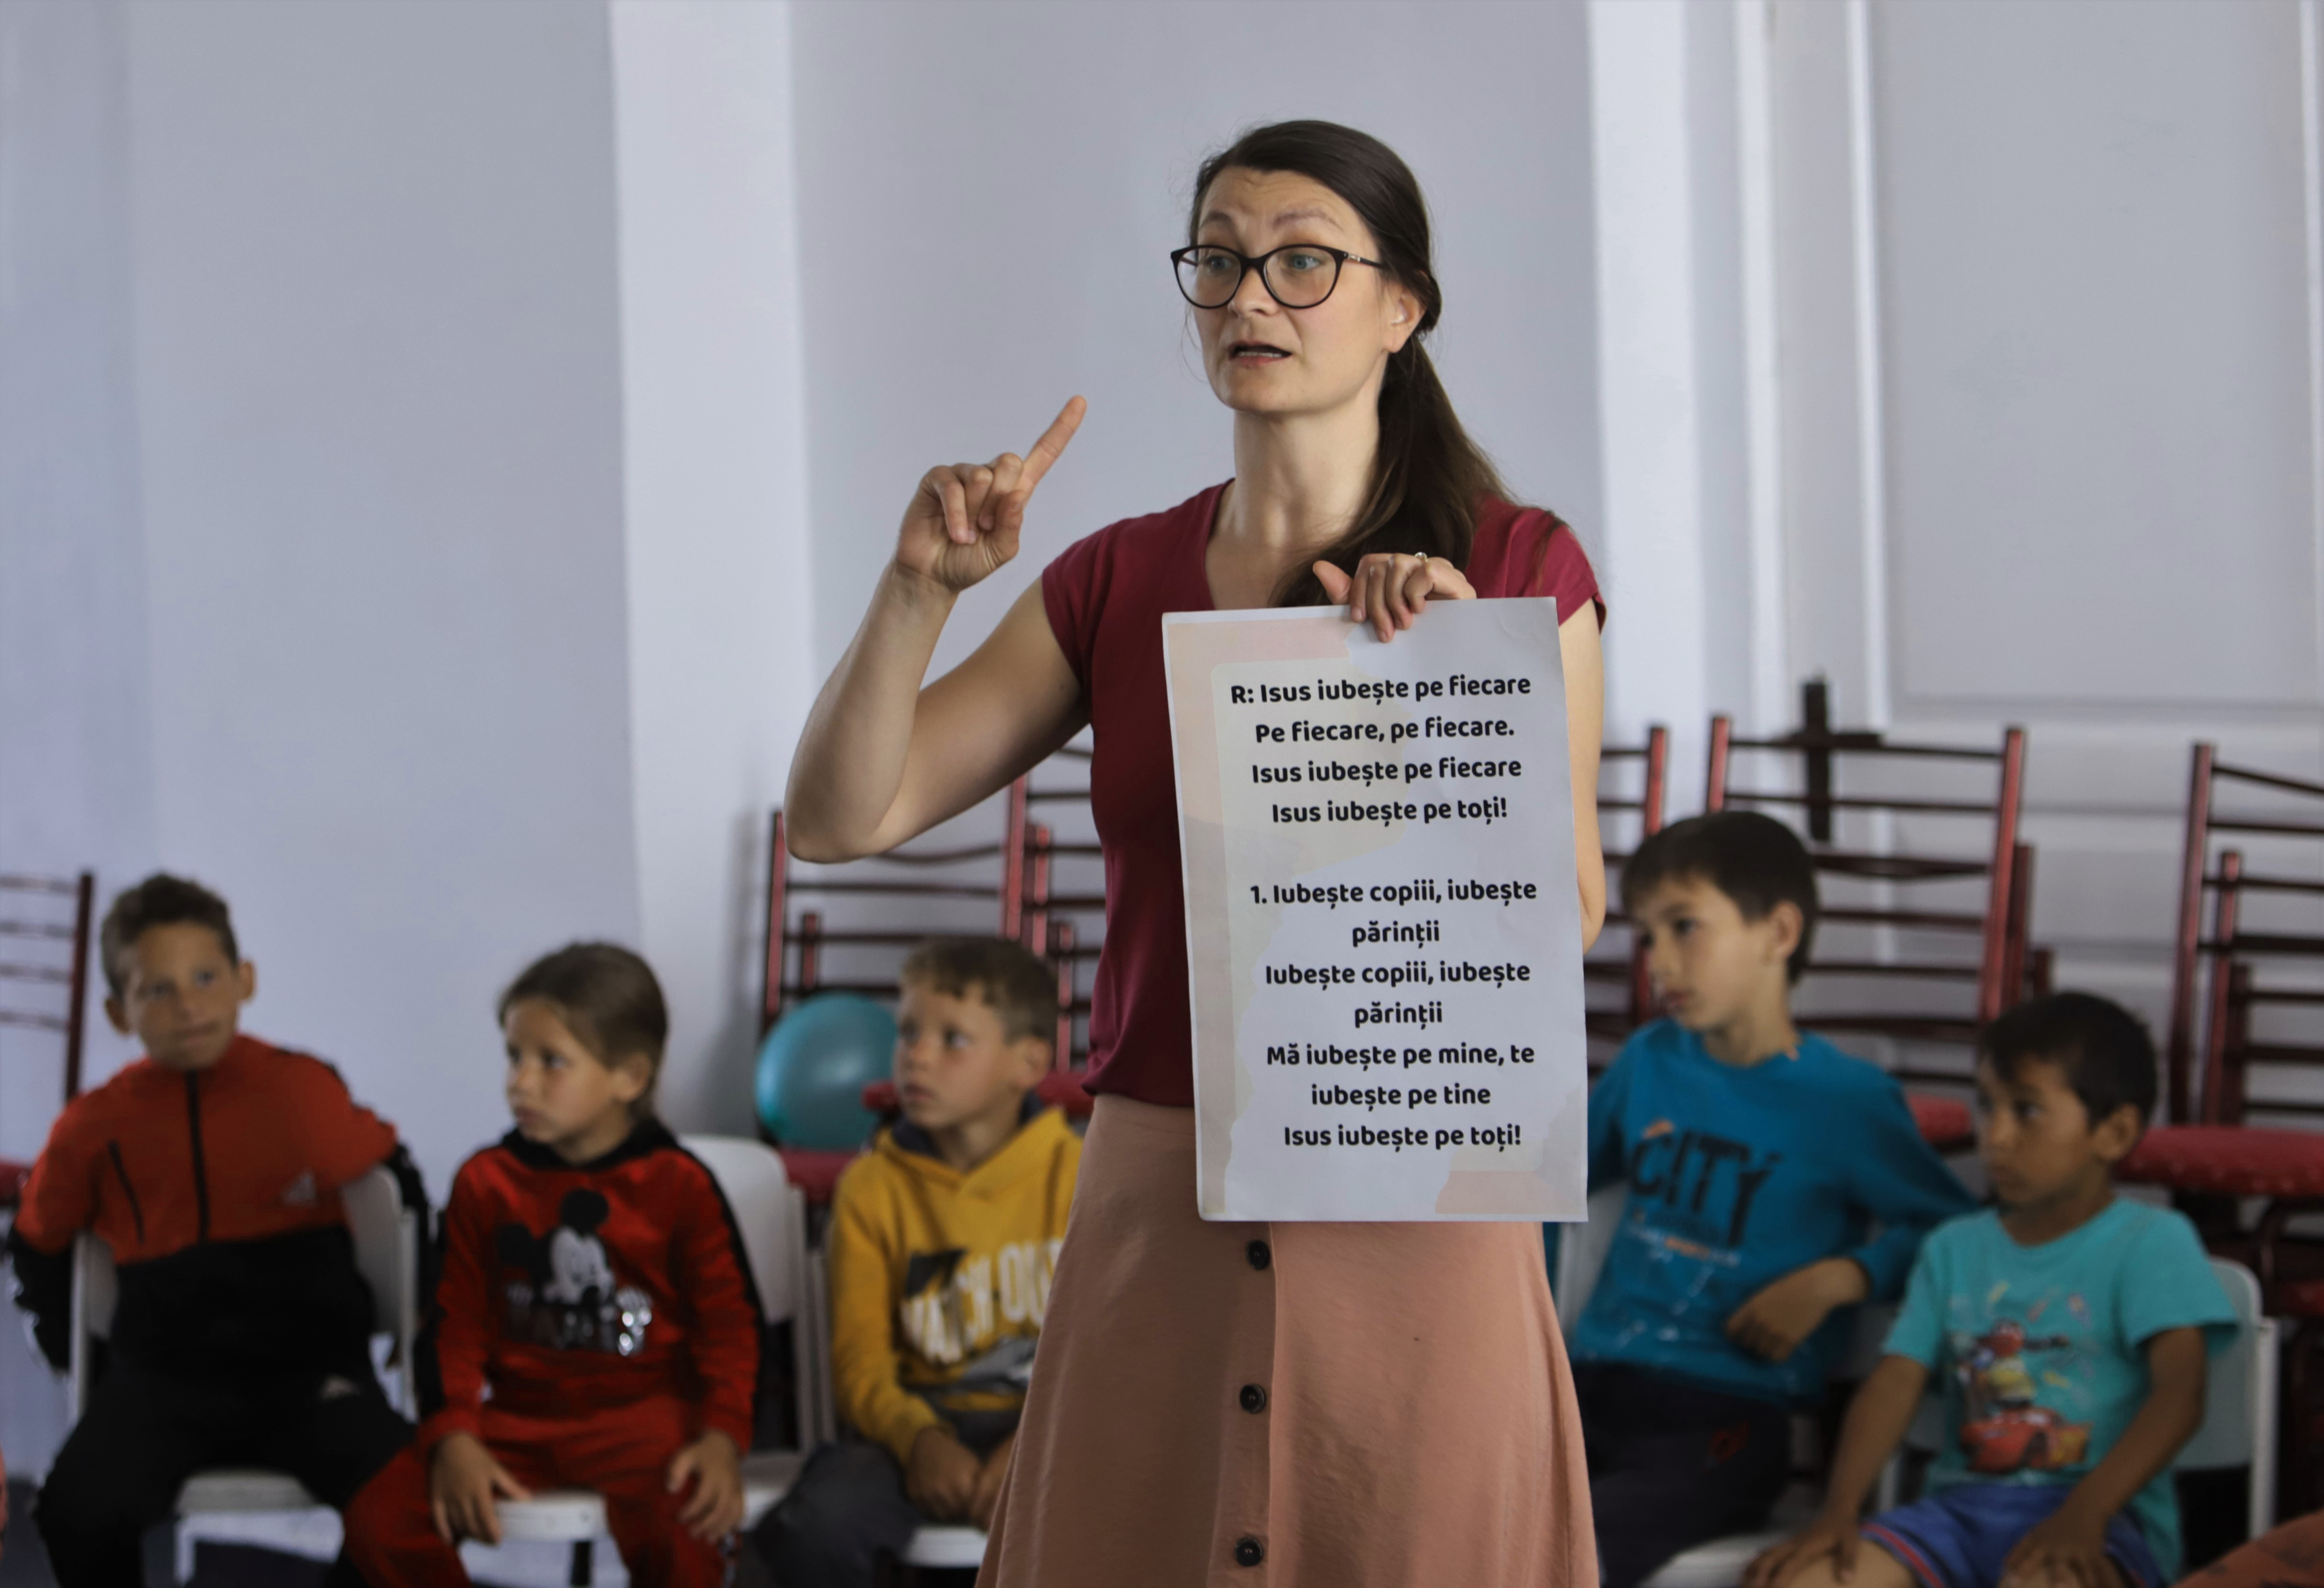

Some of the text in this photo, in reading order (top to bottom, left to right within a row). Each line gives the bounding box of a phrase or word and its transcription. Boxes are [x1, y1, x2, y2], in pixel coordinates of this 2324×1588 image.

[1231, 674, 1531, 705] R: Isus iubește pe fiecare
[1256, 716, 1514, 744] Pe fiecare, pe fiecare.
[1252, 756, 1521, 787] Isus iubește pe fiecare
[1272, 796, 1507, 827] Isus iubește pe toți!
[1250, 878, 1537, 909] 1. Iubește copiii, iubește
[1352, 920, 1439, 949] părinții
[1266, 960, 1530, 991] Iubește copiii, iubește
[1355, 1001, 1442, 1030] părinții
[1267, 1042, 1534, 1071] Mă iubește pe mine, te
[1312, 1082, 1491, 1112] iubește pe tine
[1284, 1123, 1521, 1153] Isus iubește pe toți!
